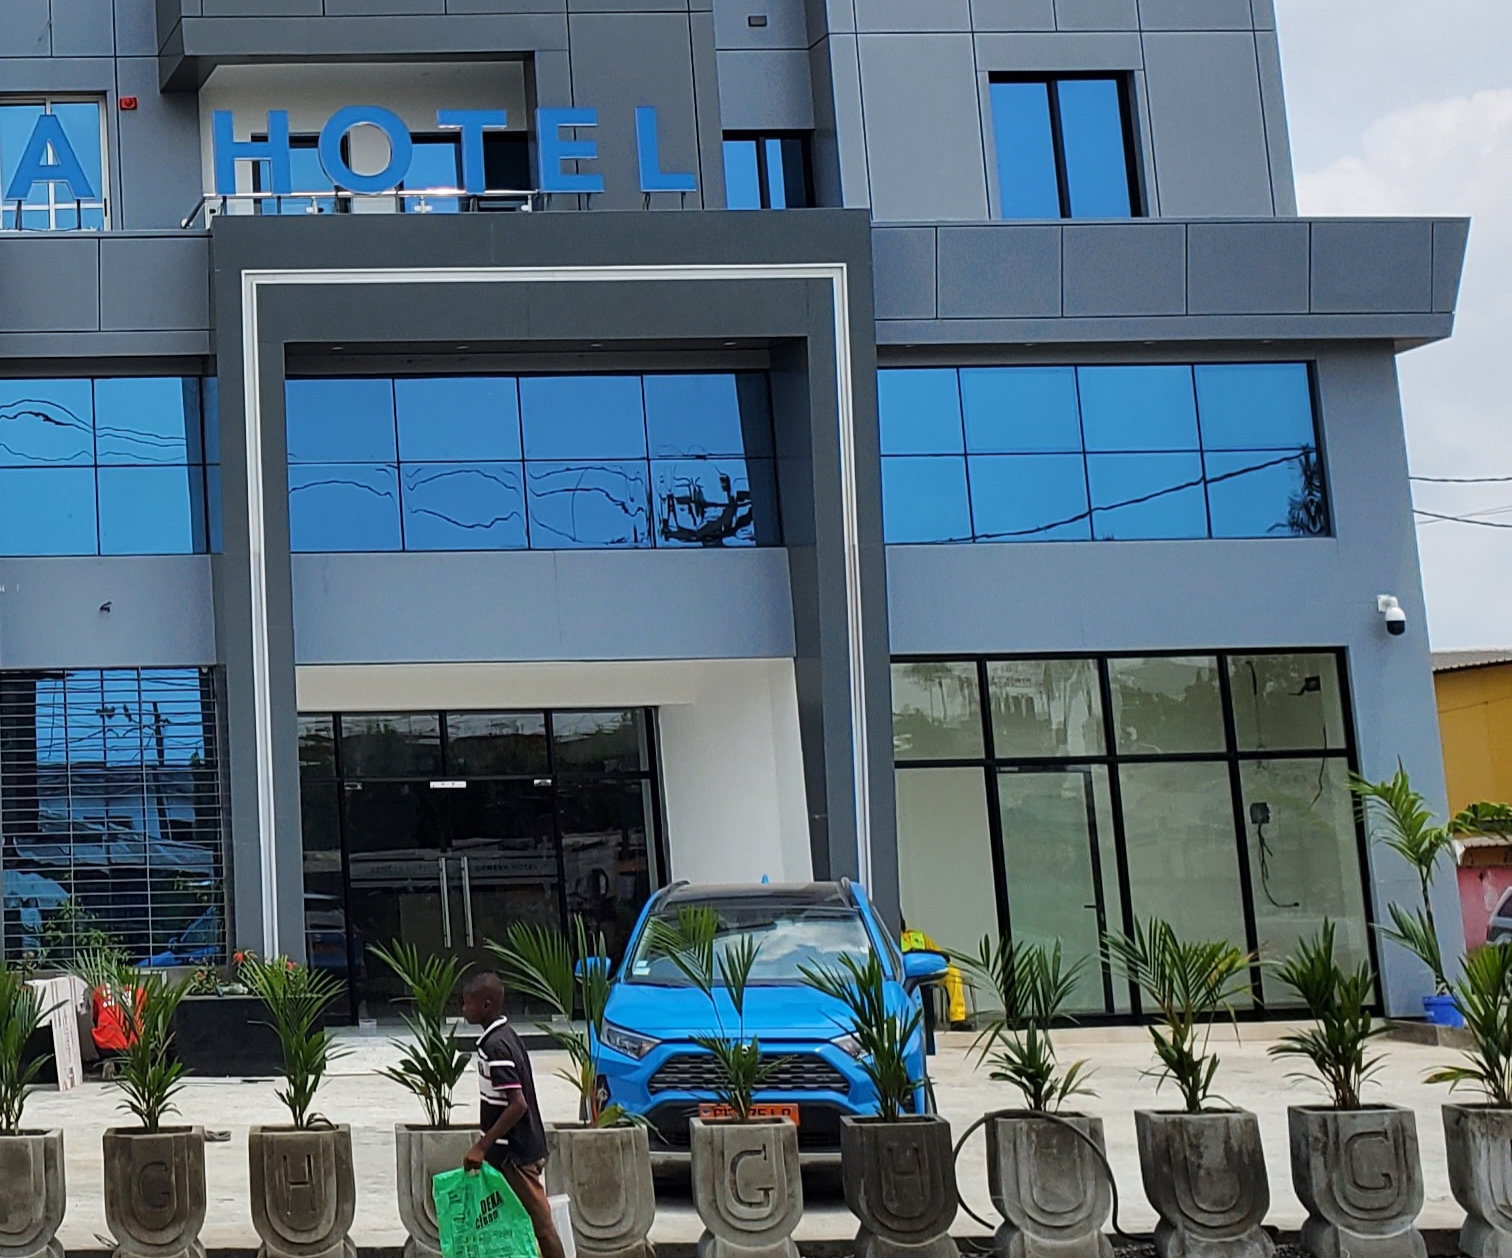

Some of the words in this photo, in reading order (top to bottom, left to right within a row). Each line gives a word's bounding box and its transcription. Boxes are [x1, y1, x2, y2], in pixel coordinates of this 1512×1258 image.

[214, 105, 696, 195] HOTEL
[139, 1161, 170, 1210] G
[282, 1153, 316, 1215] H
[729, 1143, 775, 1209] G
[1344, 1128, 1393, 1193] G
